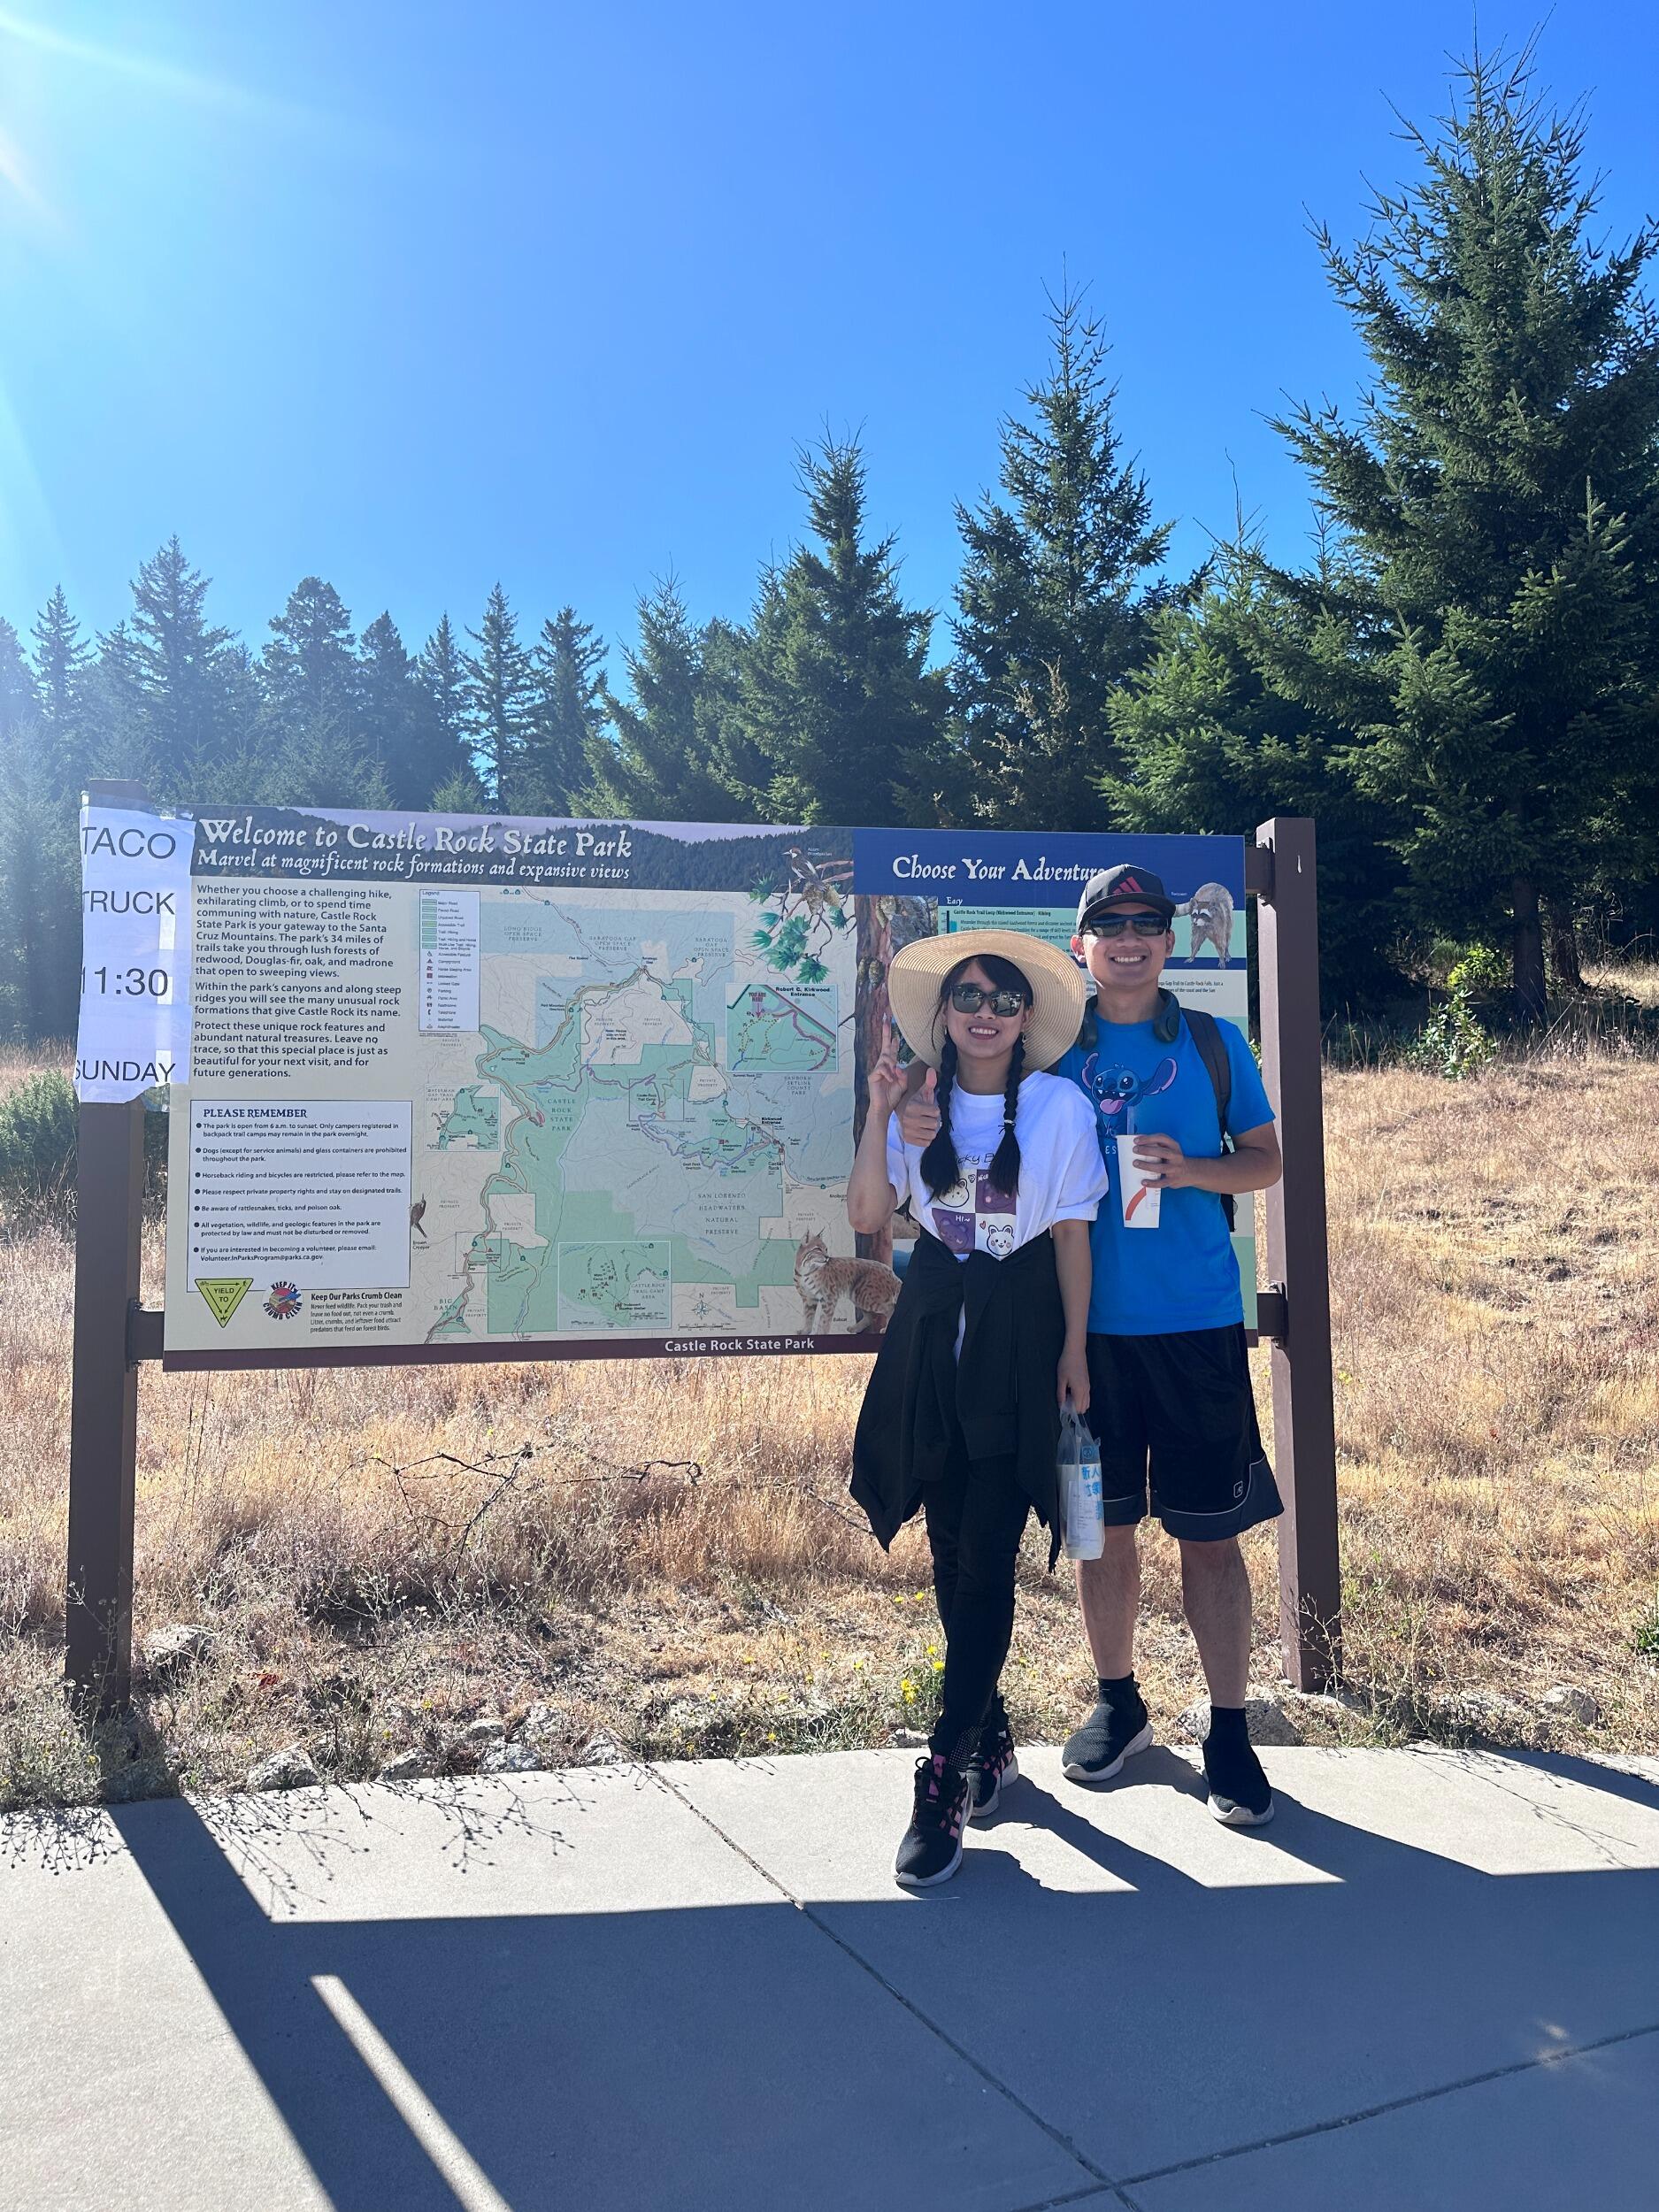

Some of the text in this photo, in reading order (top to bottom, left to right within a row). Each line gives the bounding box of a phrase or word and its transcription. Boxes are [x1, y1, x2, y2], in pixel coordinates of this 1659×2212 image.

[81, 826, 176, 859] TACO
[198, 816, 632, 858] Welcome to Castle Rock State Park
[198, 849, 630, 882] Marvel at magnificent rock formations and expansive views
[892, 855, 956, 879] Choose
[961, 858, 1005, 879] Your
[197, 885, 240, 894] Whether
[264, 887, 298, 895] choose
[309, 888, 366, 899] challenging
[369, 890, 391, 899] hike,
[197, 896, 256, 908] exhilarating
[259, 898, 288, 908] climb,
[317, 900, 346, 910] spend
[947, 897, 963, 906] Easy
[196, 910, 257, 919] communing
[259, 910, 280, 918] with
[284, 911, 318, 920] nature,
[321, 911, 350, 920] Castle
[225, 920, 246, 929] Park
[284, 923, 326, 933] gateway
[341, 923, 357, 932] the
[359, 924, 386, 933] Santa
[221, 933, 276, 941] Mountains.
[223, 943, 244, 952] take
[268, 945, 308, 956] through
[311, 945, 331, 954] lush
[334, 946, 366, 955] forests
[196, 955, 242, 964] redwood,
[246, 956, 302, 966] Douglas-fir,
[305, 957, 326, 966] oak,
[196, 966, 216, 975] that
[259, 968, 306, 979] sweeping
[230, 982, 247, 991] the
[281, 986, 321, 995] canyons
[346, 985, 373, 995] along
[376, 987, 401, 995] steep
[196, 994, 226, 1004] ridges
[195, 1005, 249, 1014] formations
[251, 1006, 272, 1015] that
[274, 1007, 296, 1017] give
[195, 1021, 230, 1030] Protect
[264, 1022, 297, 1032] unique
[324, 1023, 364, 1032] features
[204, 1109, 245, 1118] PLEASE
[271, 1281, 287, 1290] KEEP
[264, 1302, 303, 1320] CRUMB CLEAN
[665, 1338, 814, 1352] Castle Rock State Park
